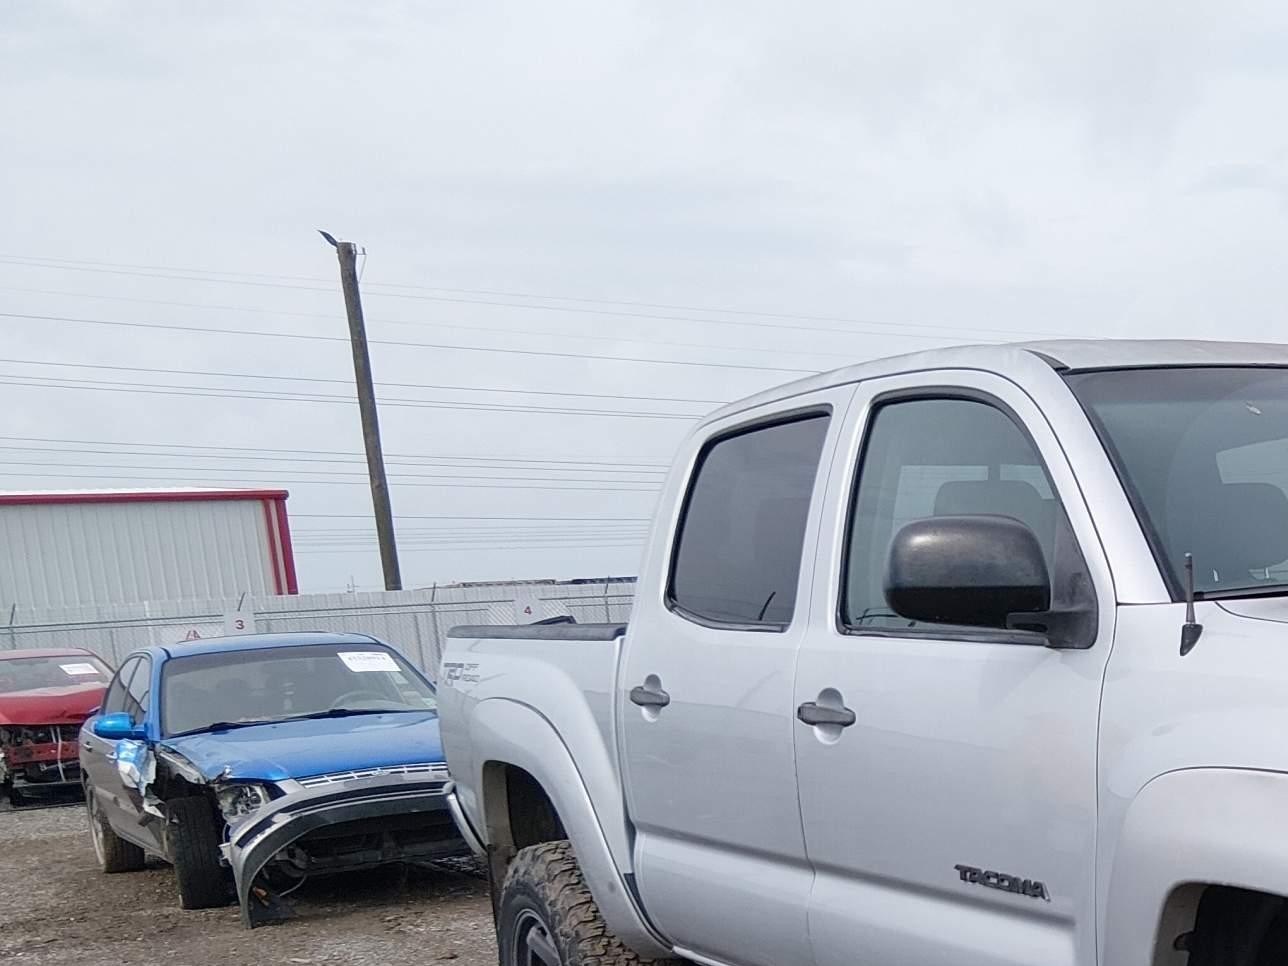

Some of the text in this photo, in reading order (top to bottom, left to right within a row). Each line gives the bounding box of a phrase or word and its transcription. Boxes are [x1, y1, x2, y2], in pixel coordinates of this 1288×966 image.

[523, 605, 532, 615] 4
[234, 618, 245, 631] 3
[953, 863, 1051, 903] TACOMA
